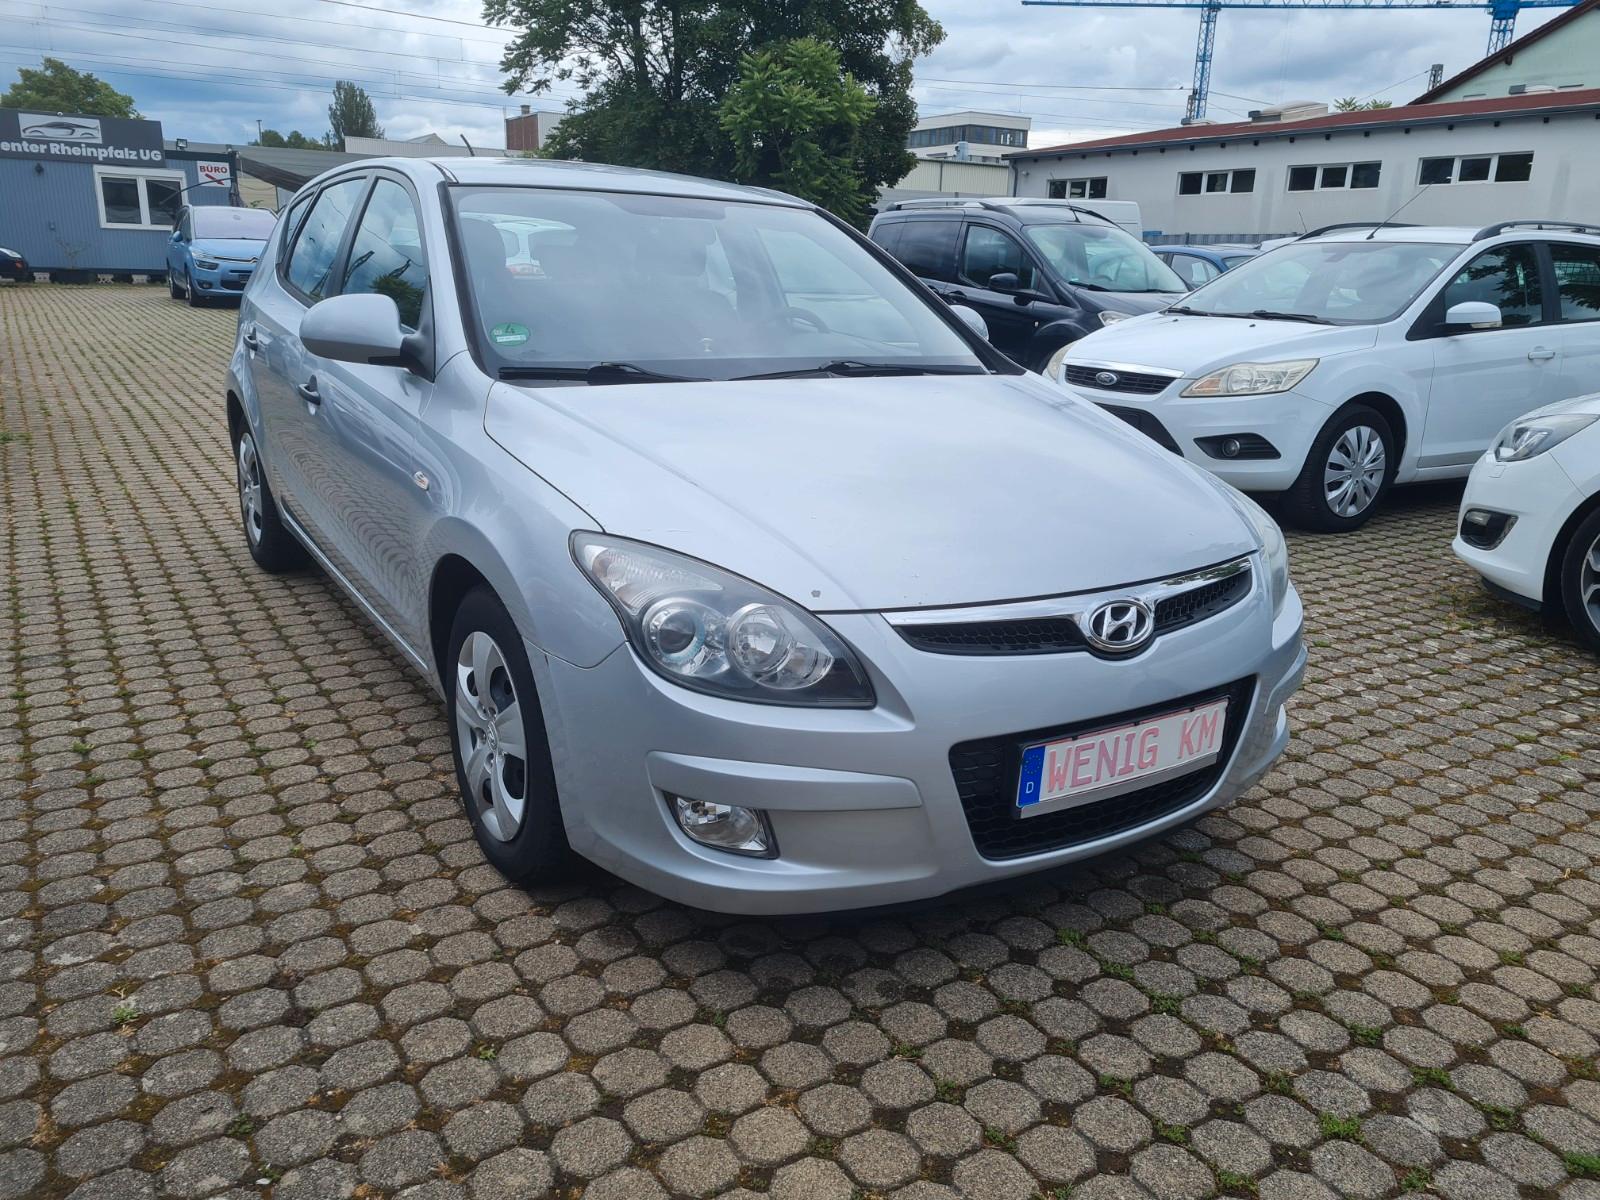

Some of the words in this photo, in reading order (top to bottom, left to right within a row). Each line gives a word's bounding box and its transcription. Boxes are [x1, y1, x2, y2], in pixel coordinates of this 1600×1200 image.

[49, 143, 137, 160] Rheinpfalz
[139, 149, 162, 161] UG
[1048, 727, 1160, 792] WENIG
[1177, 709, 1219, 759] KM
[1025, 781, 1034, 794] D
